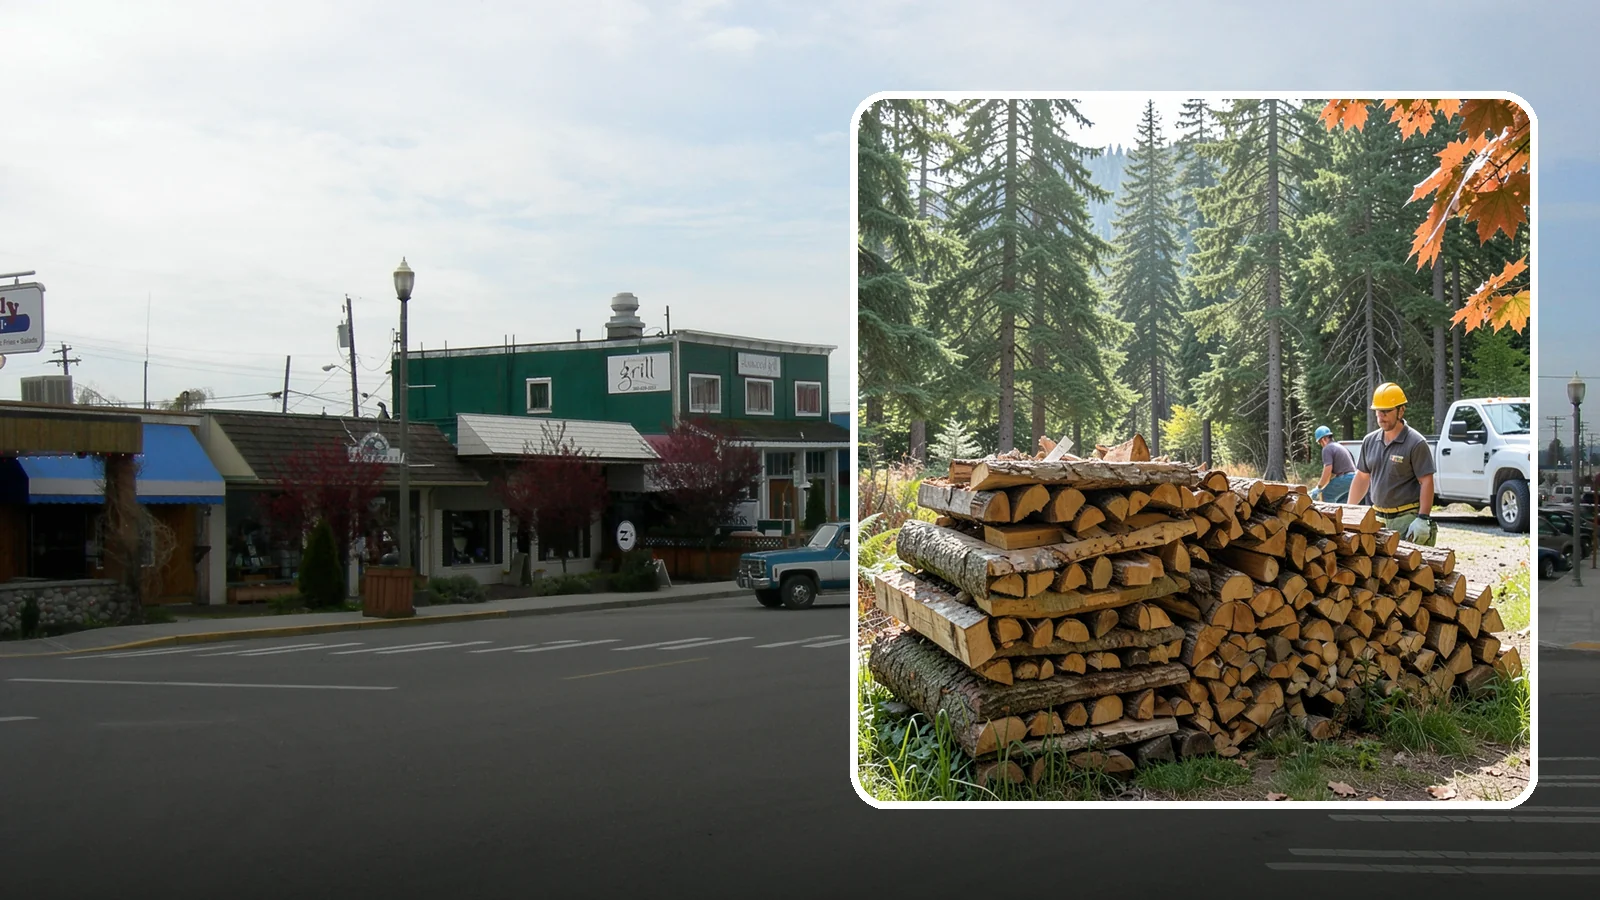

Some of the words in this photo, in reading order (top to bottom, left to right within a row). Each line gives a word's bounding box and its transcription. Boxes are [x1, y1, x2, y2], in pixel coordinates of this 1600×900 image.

[3, 338, 16, 346] Fries
[20, 337, 38, 345] Salads
[617, 356, 655, 391] grill
